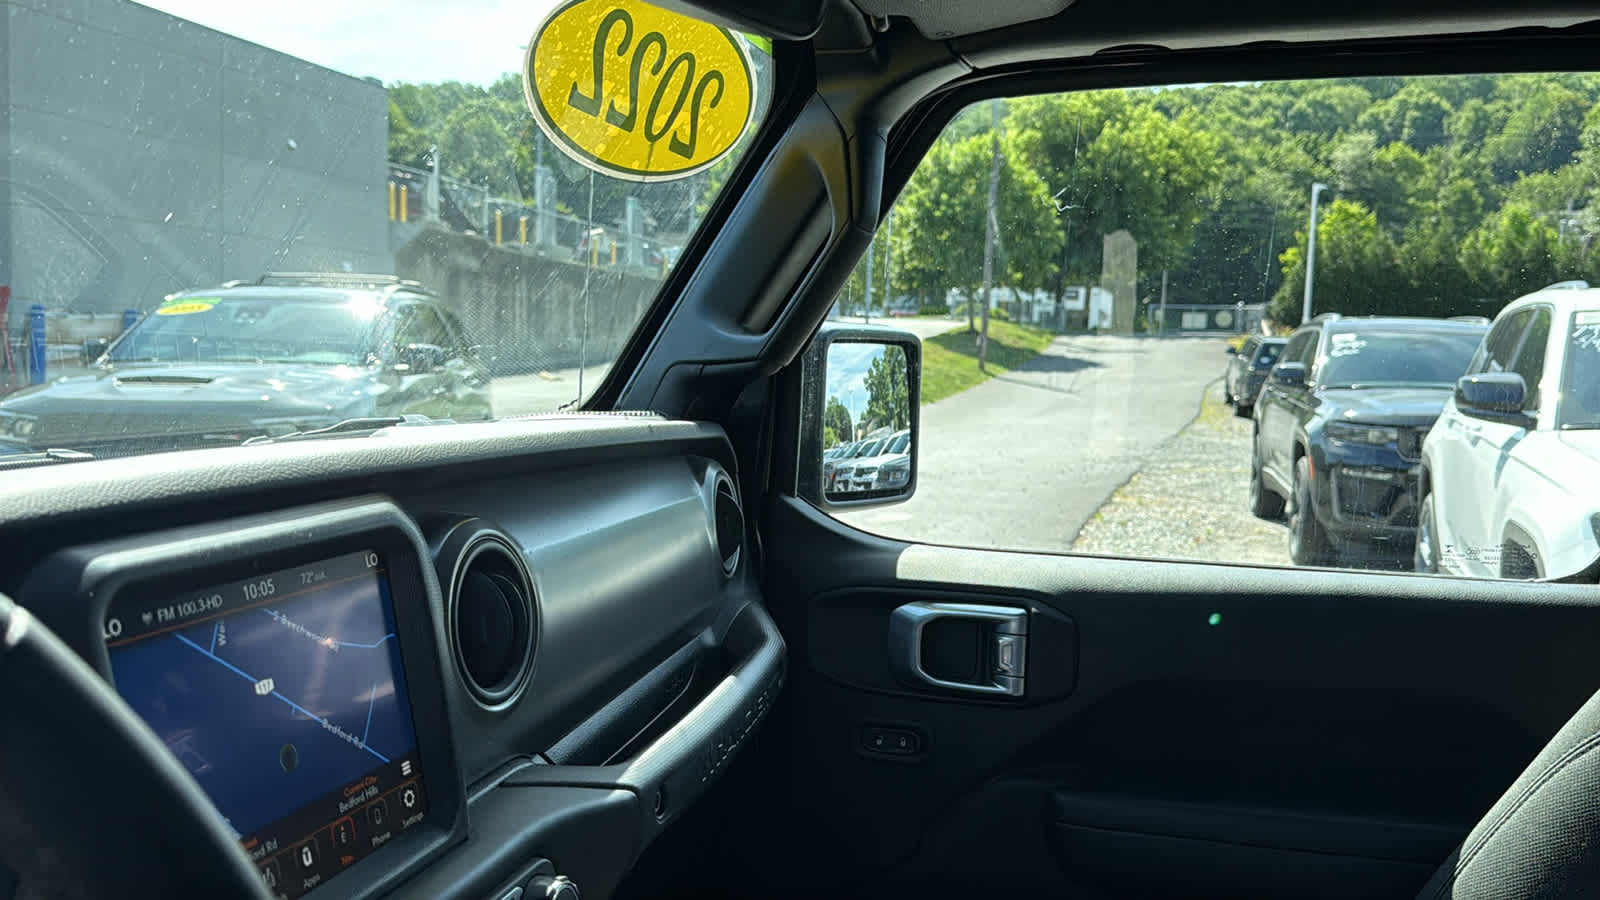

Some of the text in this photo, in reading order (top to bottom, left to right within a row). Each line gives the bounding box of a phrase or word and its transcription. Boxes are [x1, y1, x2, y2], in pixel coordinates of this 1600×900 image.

[364, 552, 378, 568] LO
[242, 579, 276, 601] 10:05
[157, 606, 176, 623] FM
